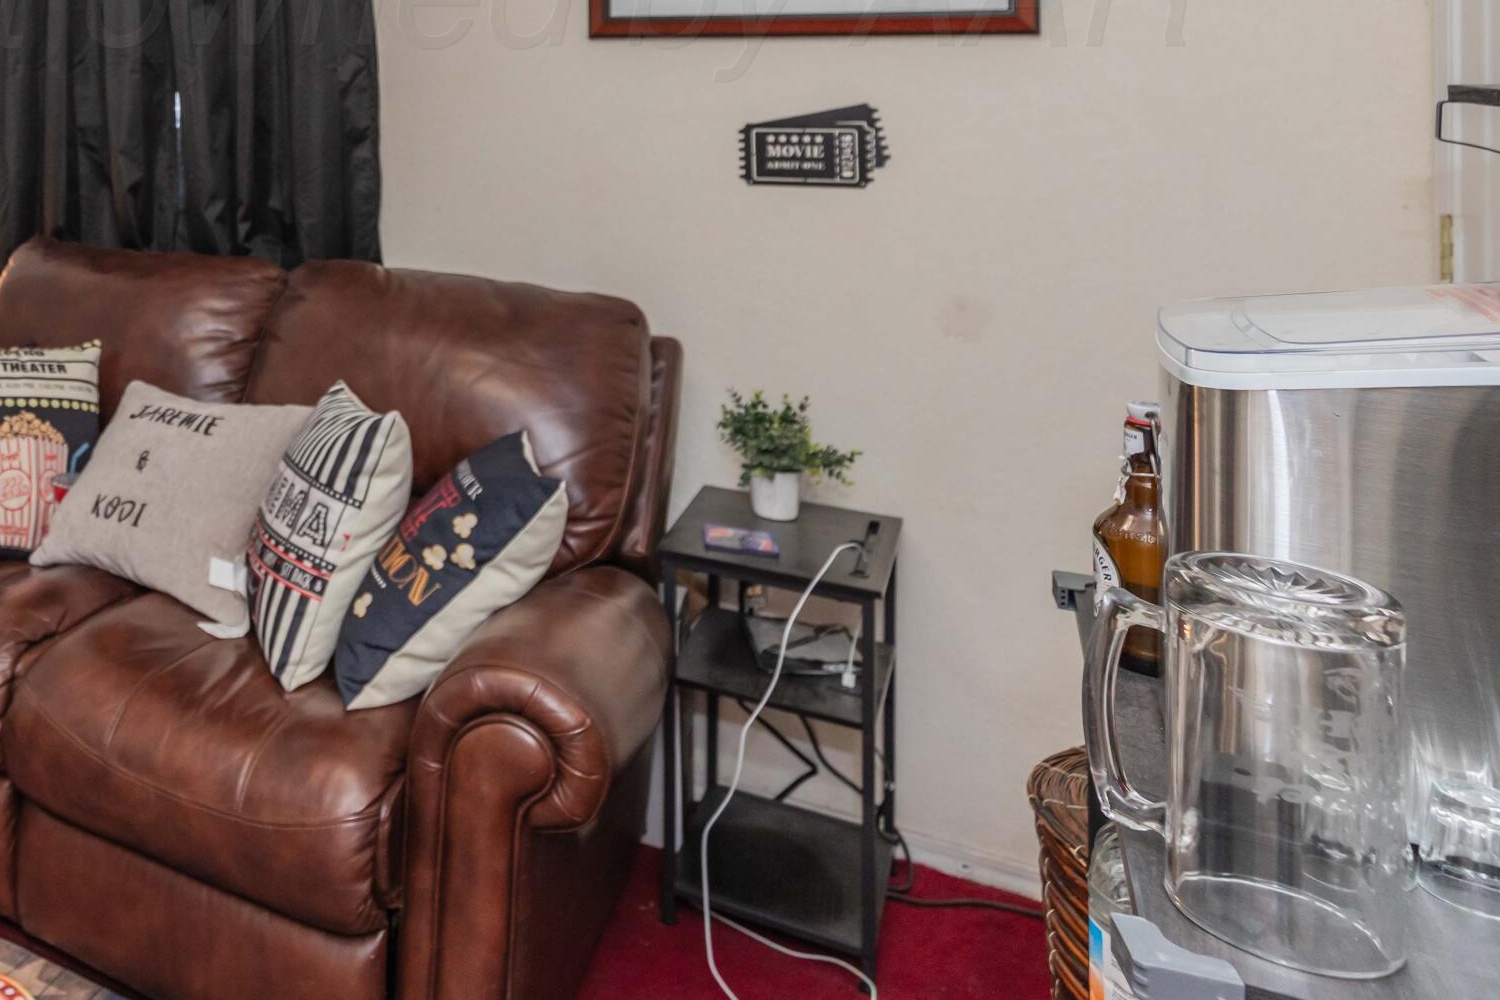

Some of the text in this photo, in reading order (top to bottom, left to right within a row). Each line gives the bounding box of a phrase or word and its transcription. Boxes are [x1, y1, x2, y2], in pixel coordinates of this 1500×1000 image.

[766, 144, 825, 159] MOVIE
[766, 160, 825, 171] ADMIT ONE
[0, 362, 67, 374] THEATER
[130, 404, 224, 436] JAREMIE
[92, 493, 148, 528] KODI
